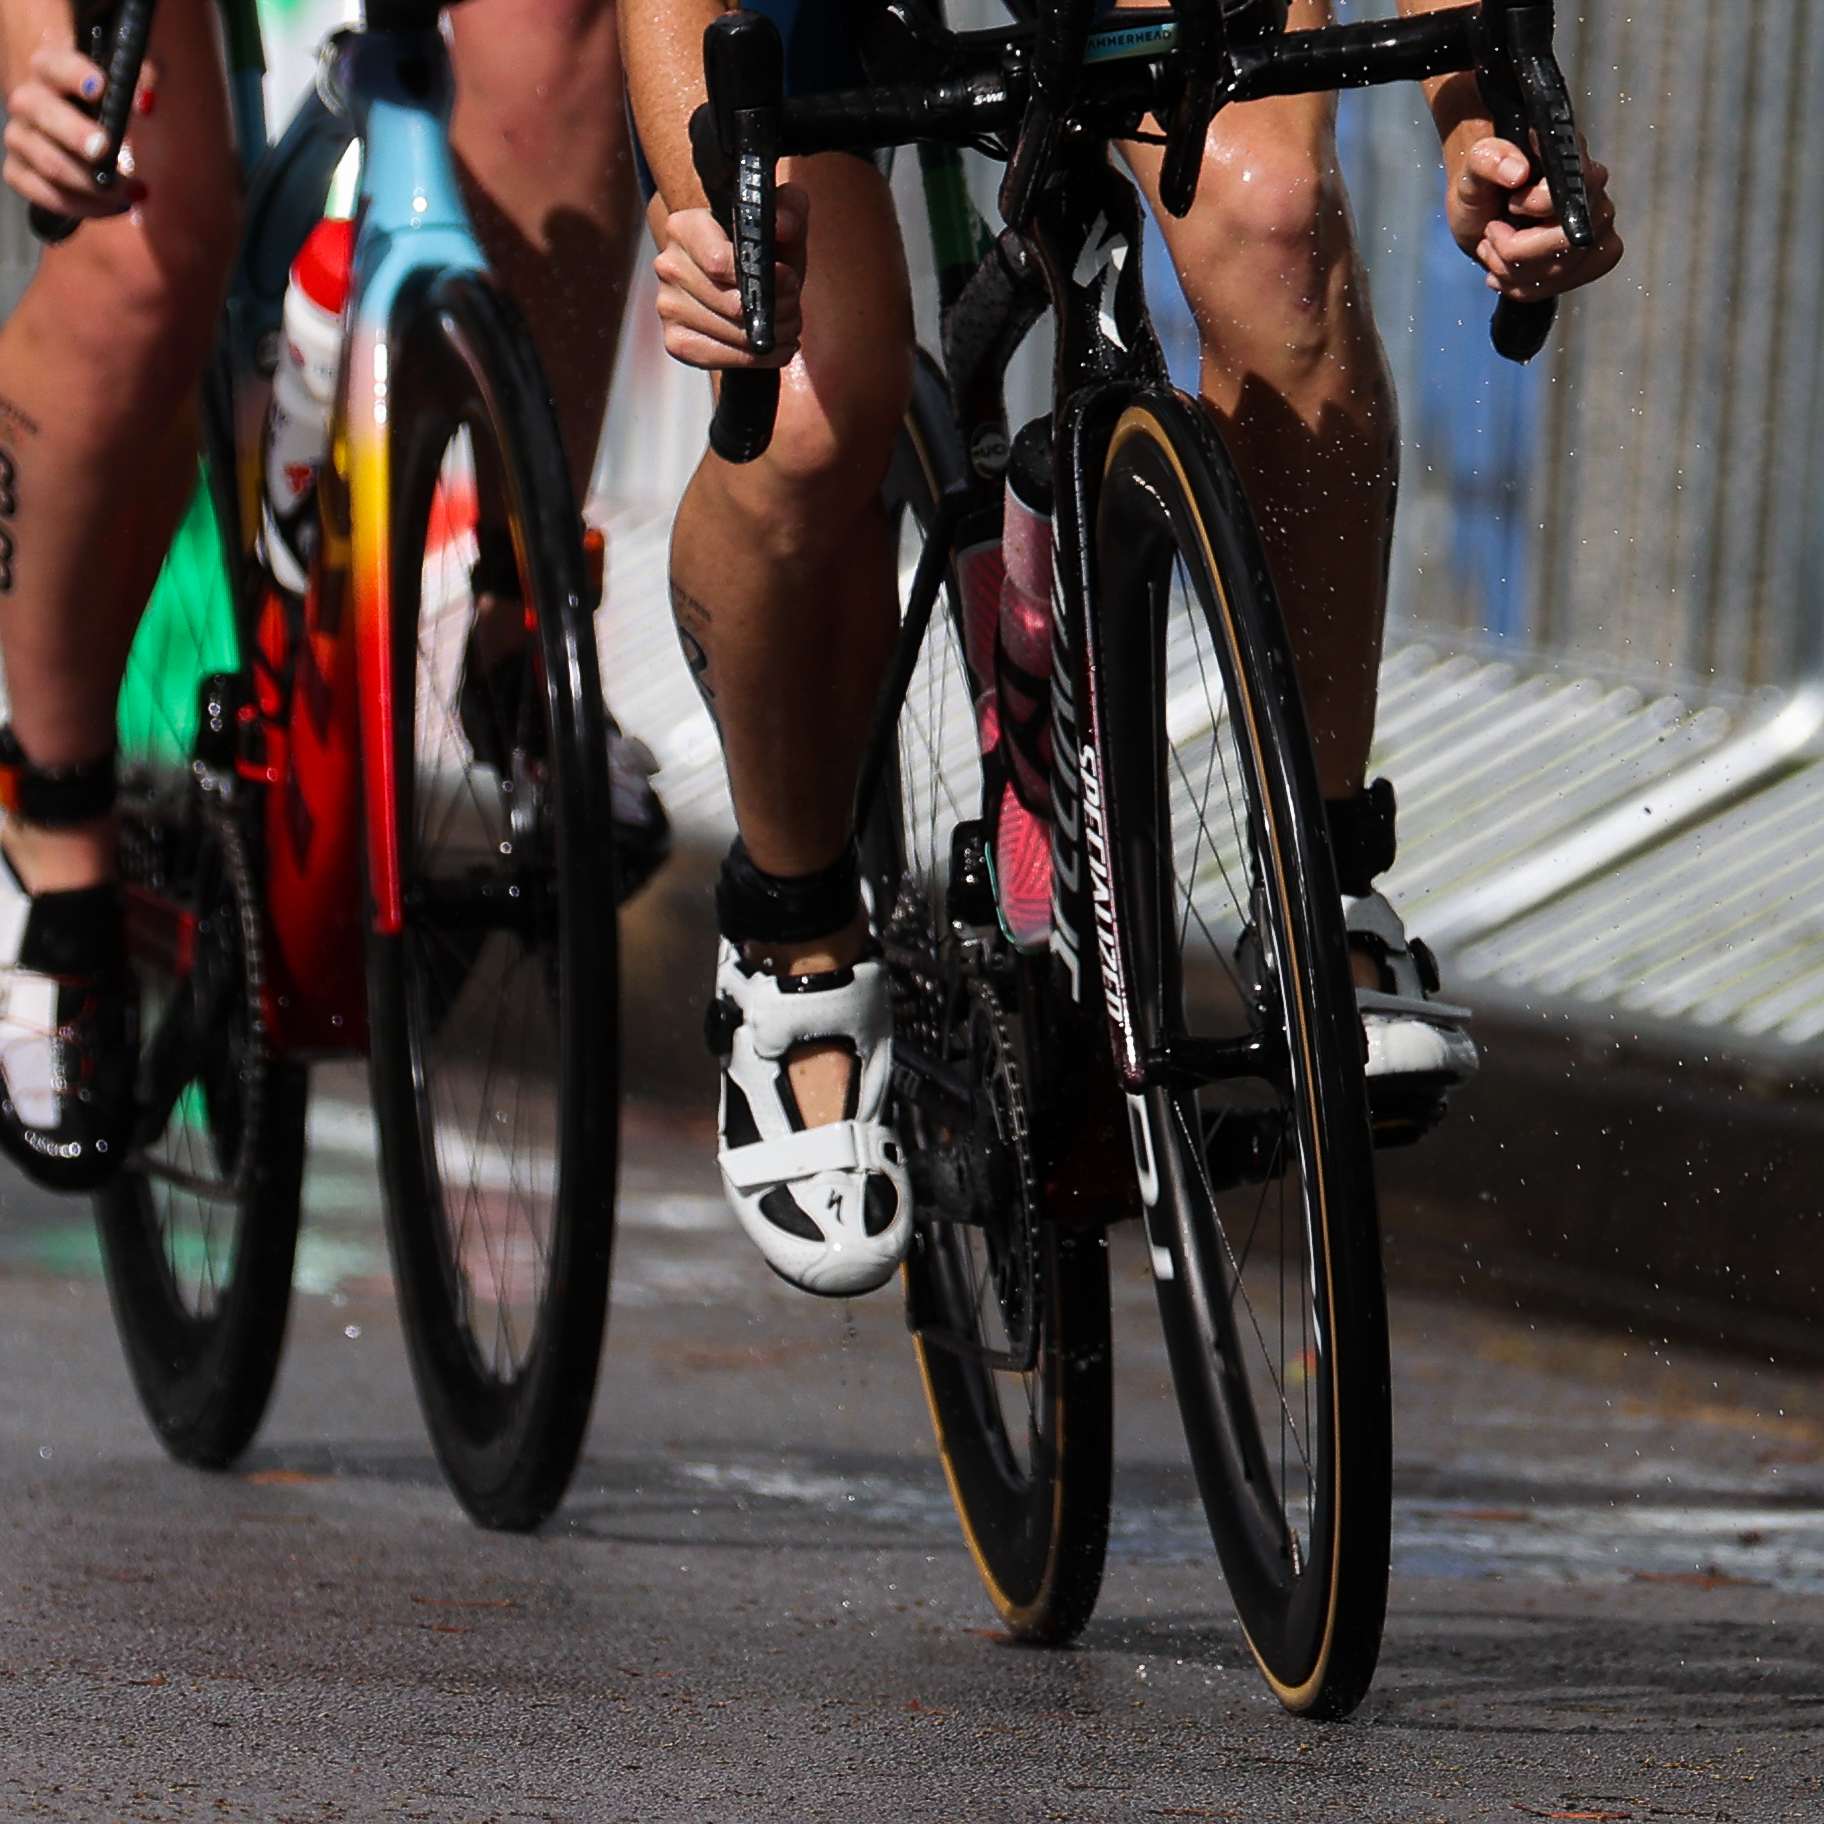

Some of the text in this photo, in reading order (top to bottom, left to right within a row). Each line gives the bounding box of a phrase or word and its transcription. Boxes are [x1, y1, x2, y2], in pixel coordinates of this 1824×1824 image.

[1085, 28, 1173, 51] AMMERHEAD
[738, 153, 763, 312] SRAM
[1079, 743, 1125, 1023] SPECIALIZED
